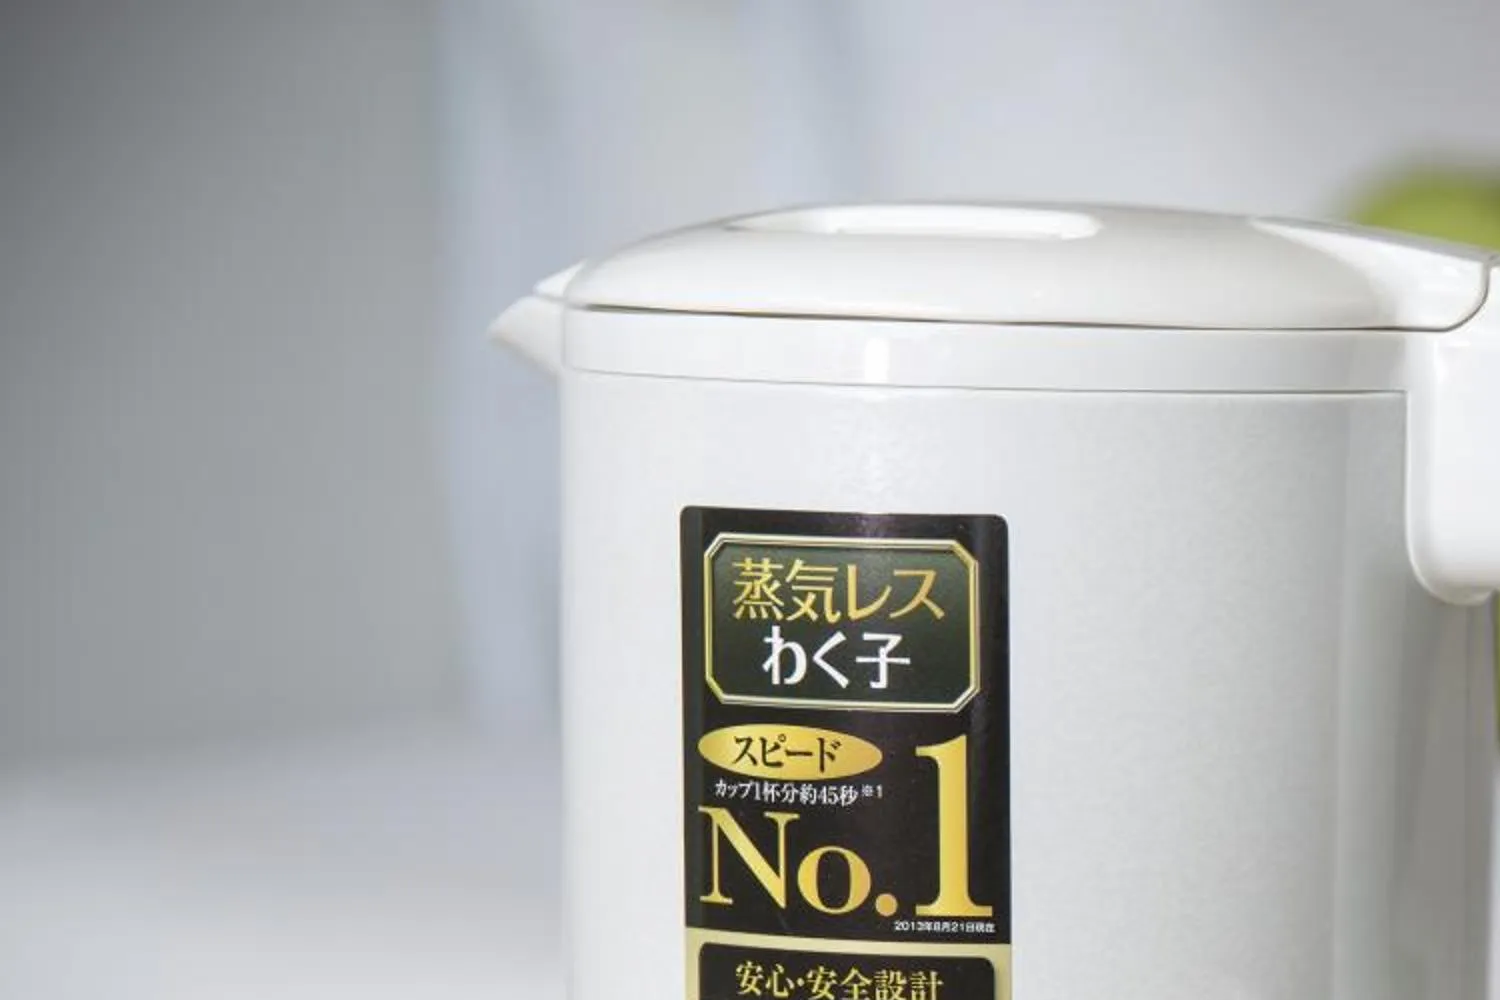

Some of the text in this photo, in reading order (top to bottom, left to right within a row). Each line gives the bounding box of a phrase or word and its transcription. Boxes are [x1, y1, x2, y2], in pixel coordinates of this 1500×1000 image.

[732, 557, 945, 624] 蒸気レス
[761, 625, 911, 689] わく子
[732, 733, 842, 773] スピード
